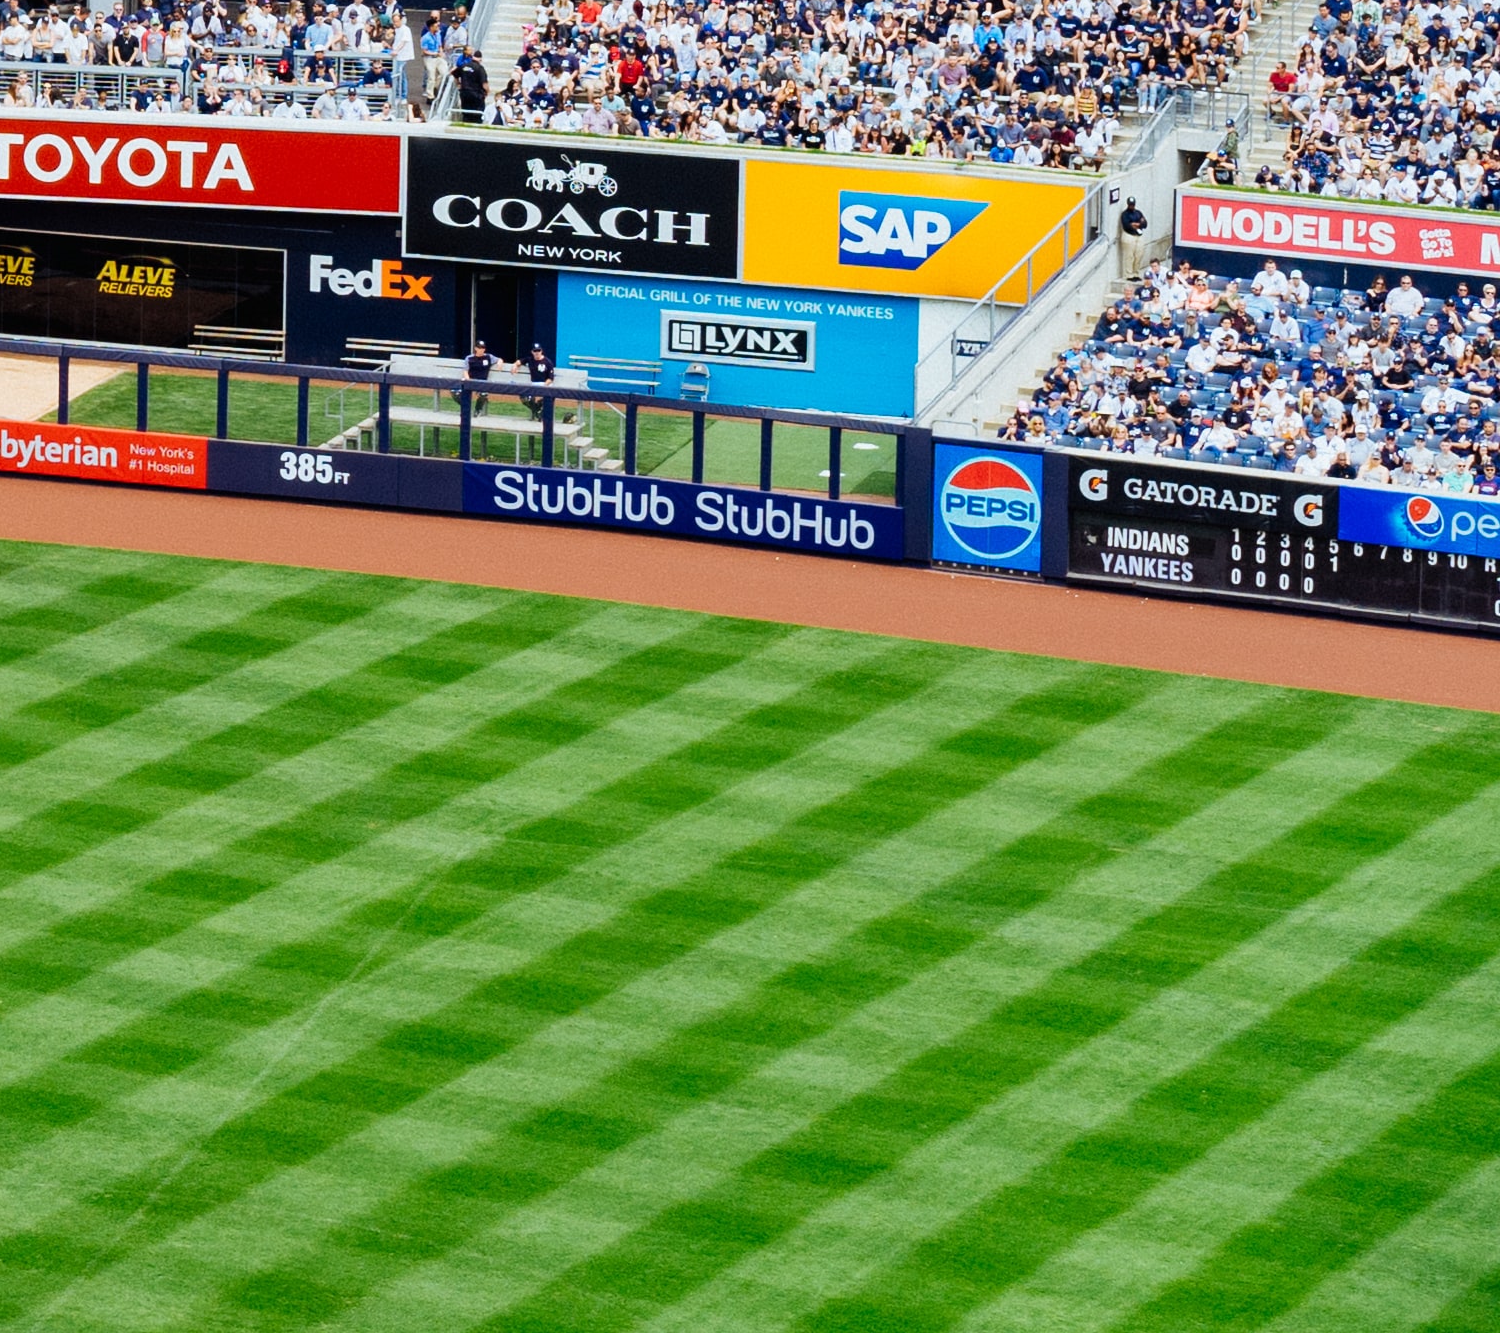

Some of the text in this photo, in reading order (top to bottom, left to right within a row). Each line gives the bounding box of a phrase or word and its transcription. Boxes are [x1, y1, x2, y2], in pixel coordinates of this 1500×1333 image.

[431, 193, 710, 246] COACH
[840, 203, 952, 258] SAP
[1199, 205, 1395, 254] MODELL'S
[517, 243, 622, 263] NEW YORK
[309, 254, 433, 301] FedEx
[586, 284, 893, 319] OFFICIAL GRILL OF THE NEW YORK YANKEES
[706, 325, 799, 354] LYNX
[280, 452, 350, 484] 385 FT
[944, 492, 1038, 522] PEPSI
[1124, 478, 1280, 516] GATORADE
[1107, 527, 1189, 556] INDIANS
[1101, 553, 1193, 582] YANKEES
